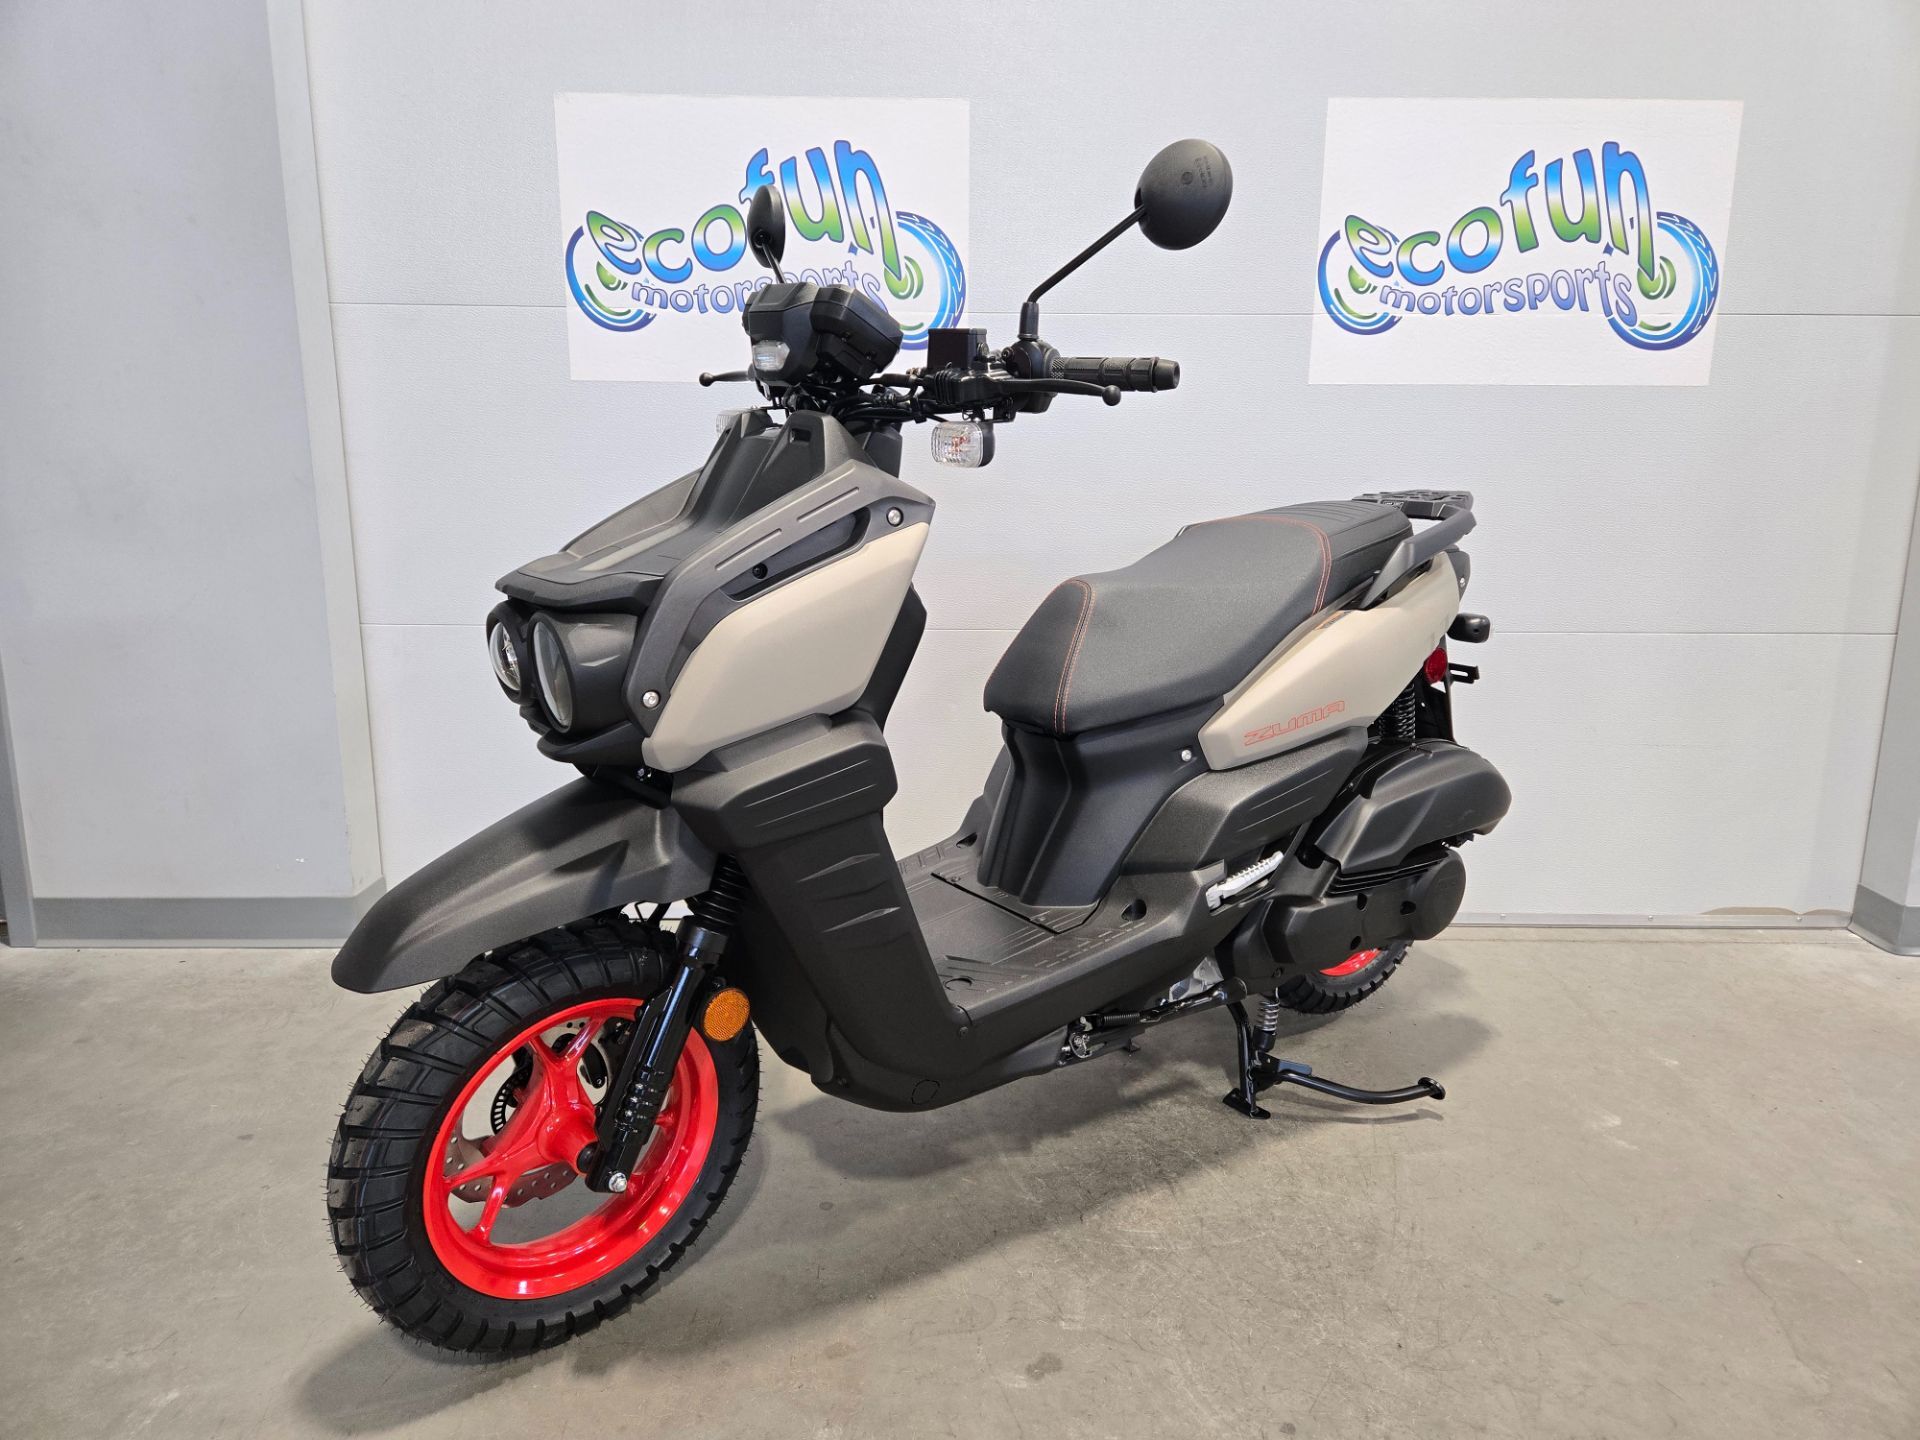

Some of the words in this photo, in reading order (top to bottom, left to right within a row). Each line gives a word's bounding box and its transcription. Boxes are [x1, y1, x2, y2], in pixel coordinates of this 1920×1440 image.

[1344, 141, 1655, 286] ecofun
[631, 260, 889, 314] motorrts
[1379, 260, 1638, 328] motorsports
[1244, 700, 1345, 746] ZUMA
